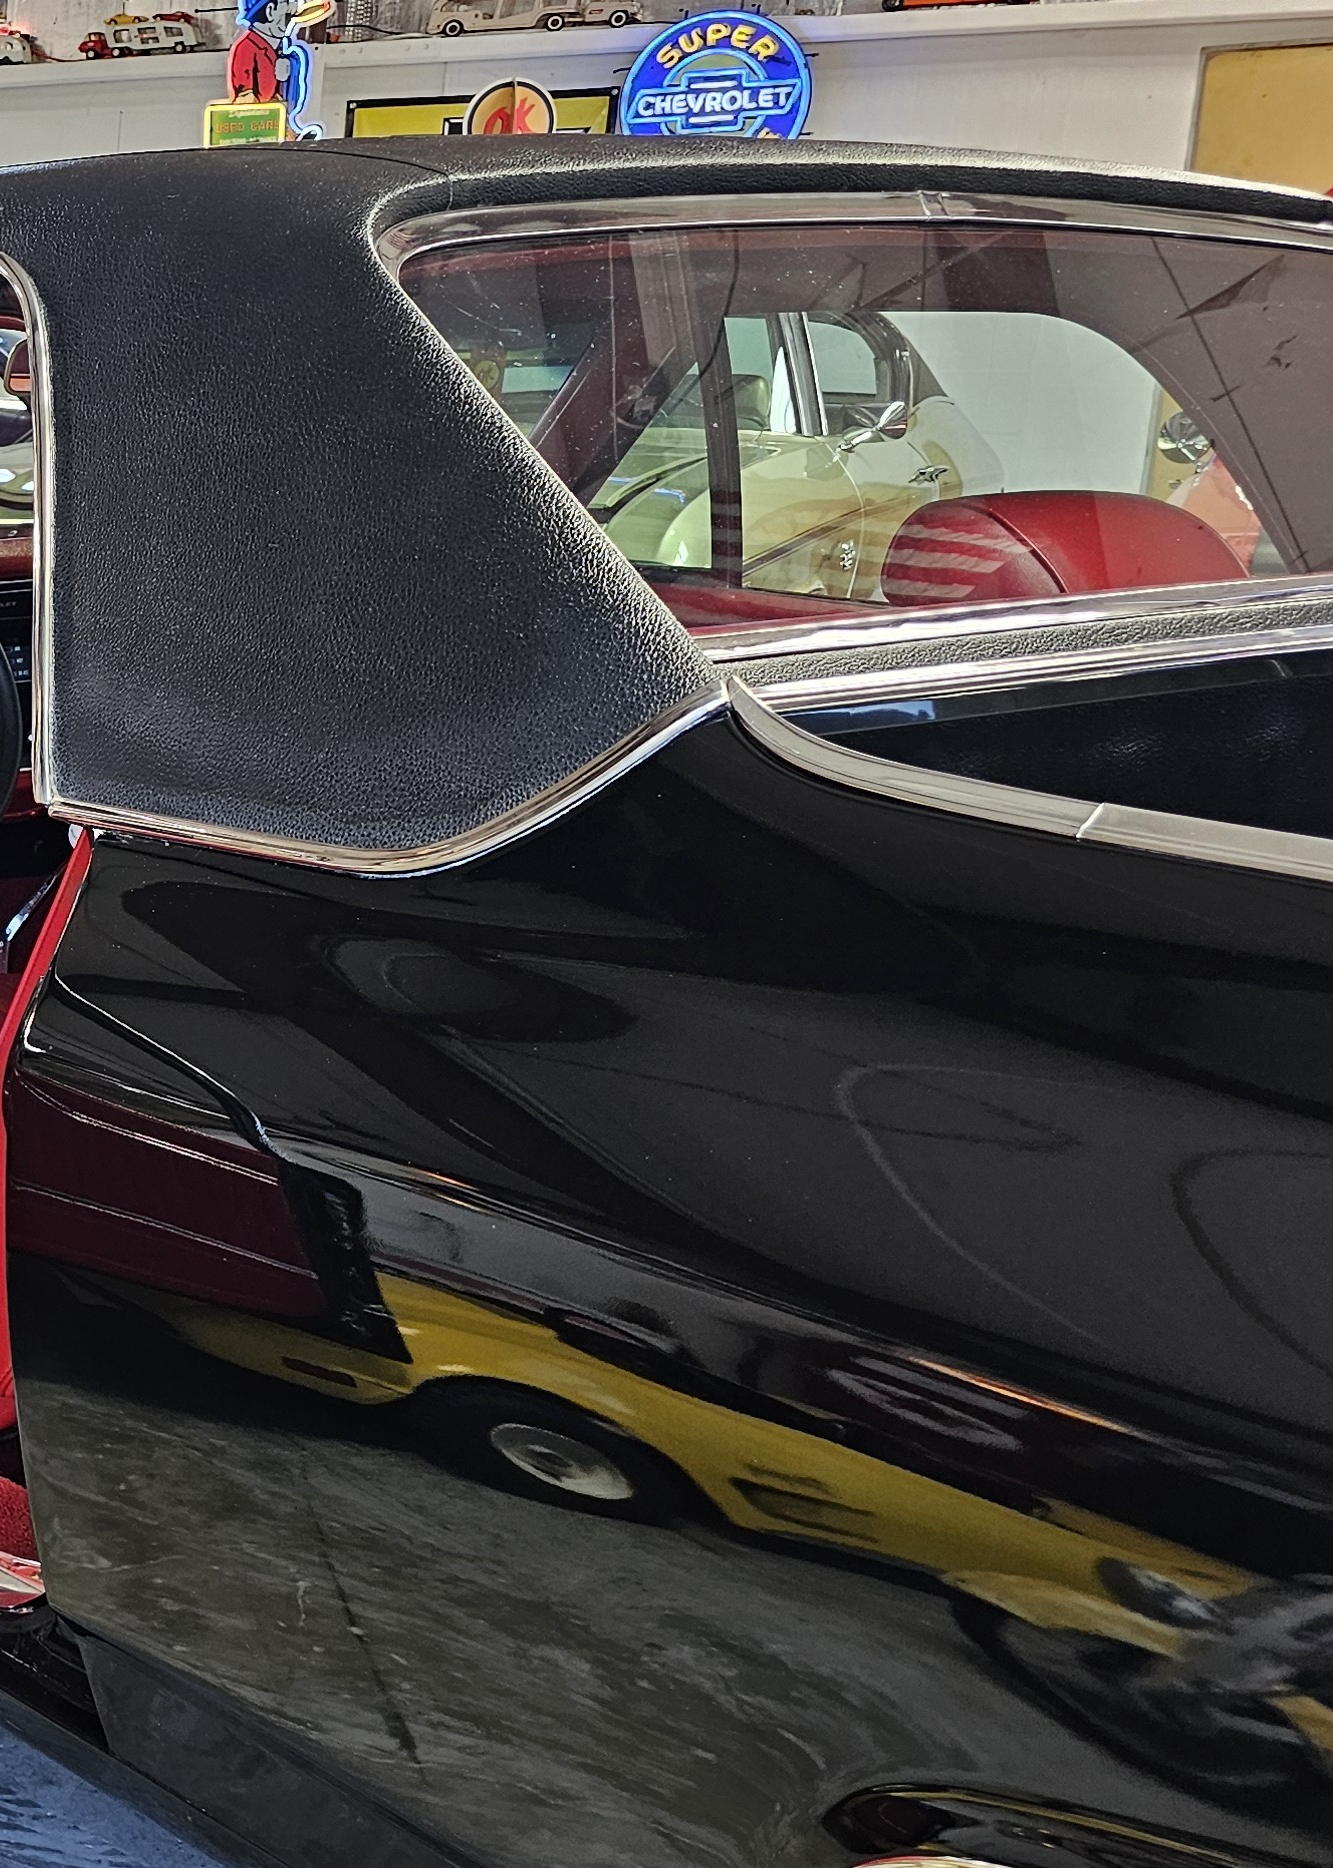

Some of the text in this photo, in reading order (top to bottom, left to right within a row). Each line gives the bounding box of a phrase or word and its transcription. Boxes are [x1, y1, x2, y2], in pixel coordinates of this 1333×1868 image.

[656, 23, 780, 68] SUPER
[484, 97, 535, 134] OK
[636, 85, 794, 117] CHEVROLET
[215, 122, 245, 134] USED
